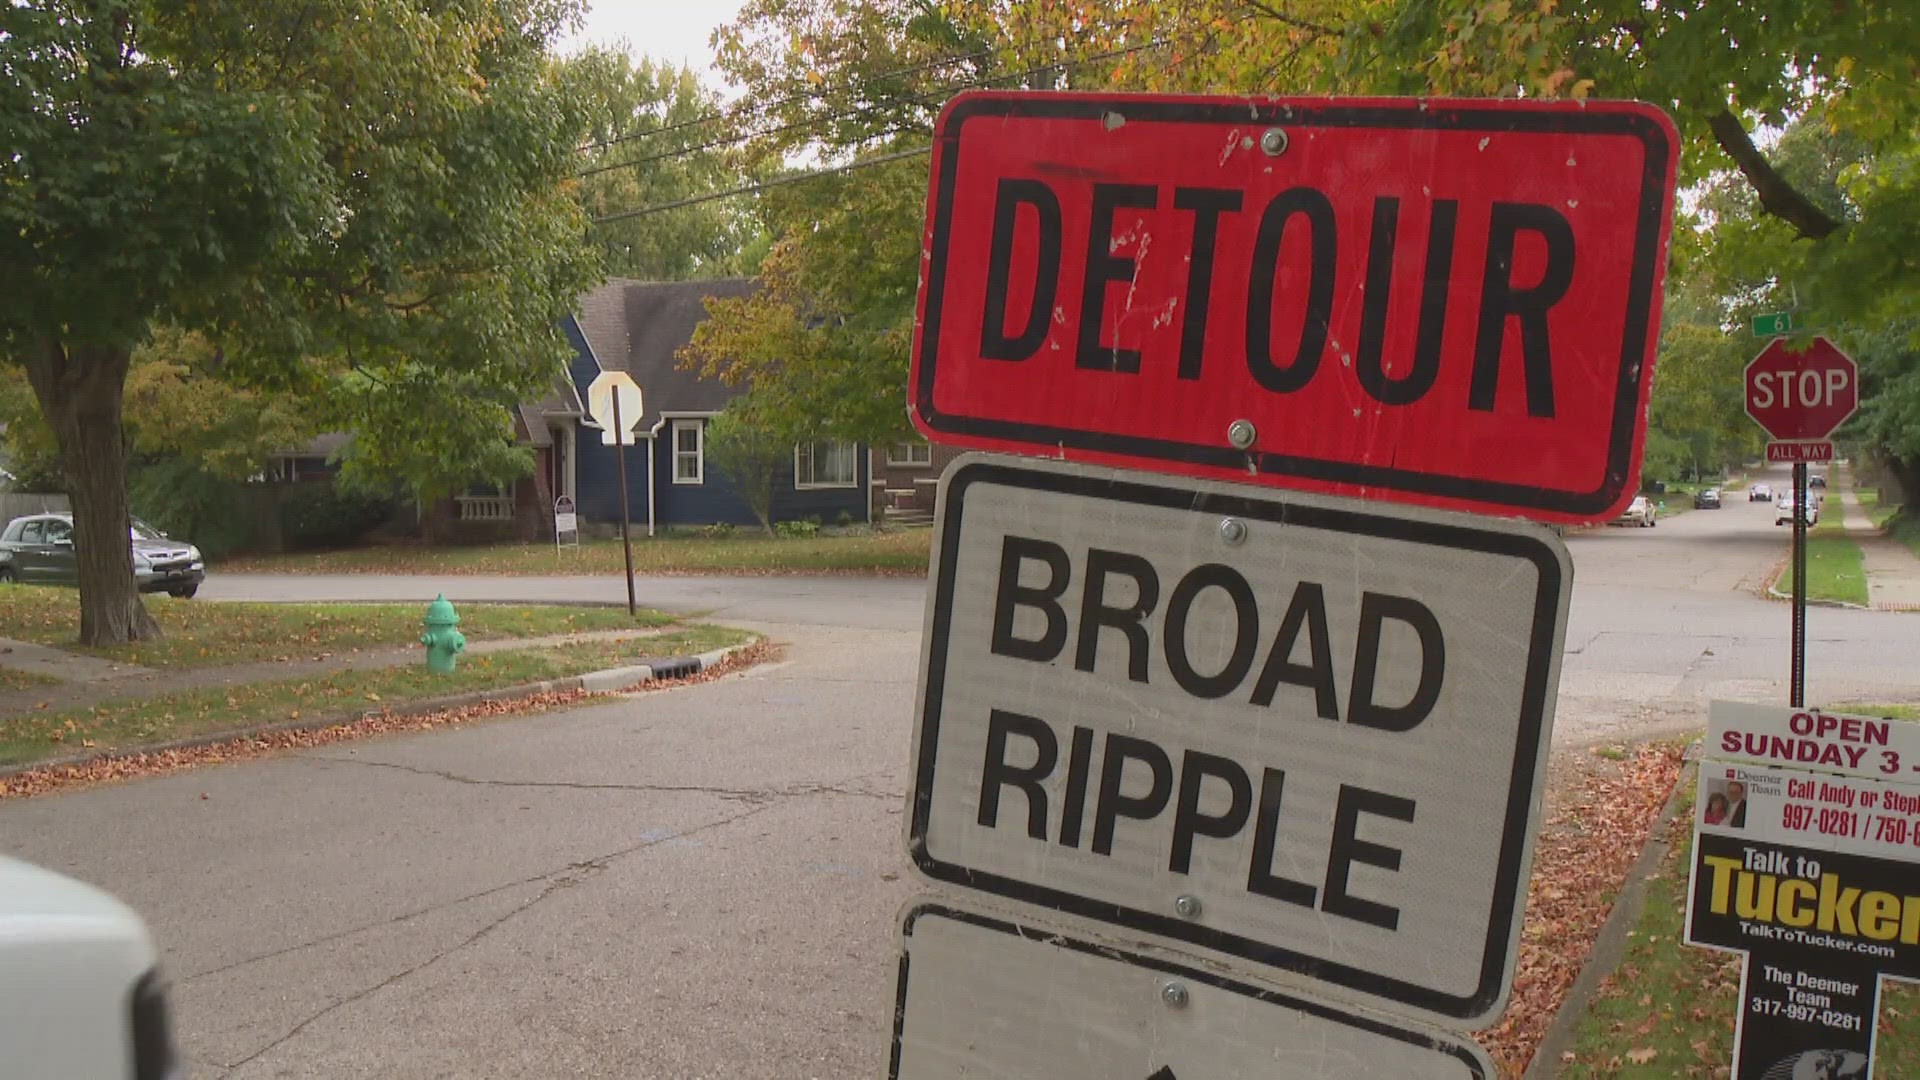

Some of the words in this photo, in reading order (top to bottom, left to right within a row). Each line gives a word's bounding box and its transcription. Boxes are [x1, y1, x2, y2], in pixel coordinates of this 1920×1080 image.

[980, 178, 1577, 418] DETOUR
[1753, 368, 1849, 408] STOP
[1772, 446, 1796, 459] ALL
[1801, 446, 1827, 459] WAY
[991, 535, 1445, 732] BROAD
[1789, 713, 1890, 746] OPEN
[1721, 731, 1868, 769] SUNDAY
[1879, 751, 1900, 774] 3
[1736, 769, 1783, 786] Deemer
[1749, 783, 1782, 797] Team
[1787, 778, 1815, 801] Call
[1819, 783, 1856, 808] Andy
[1860, 791, 1878, 808] or
[978, 708, 1416, 932] RIPPLE
[1782, 803, 1857, 838] 997-0281
[1863, 814, 1871, 839] /
[1744, 847, 1789, 875] Talk
[1796, 856, 1821, 880] to
[1739, 921, 1896, 959] TalkToTucker.com
[1763, 965, 1793, 985] The
[1796, 971, 1860, 997] Deemer
[1787, 986, 1831, 1009] Team
[1751, 997, 1862, 1031] 317-997-0281
